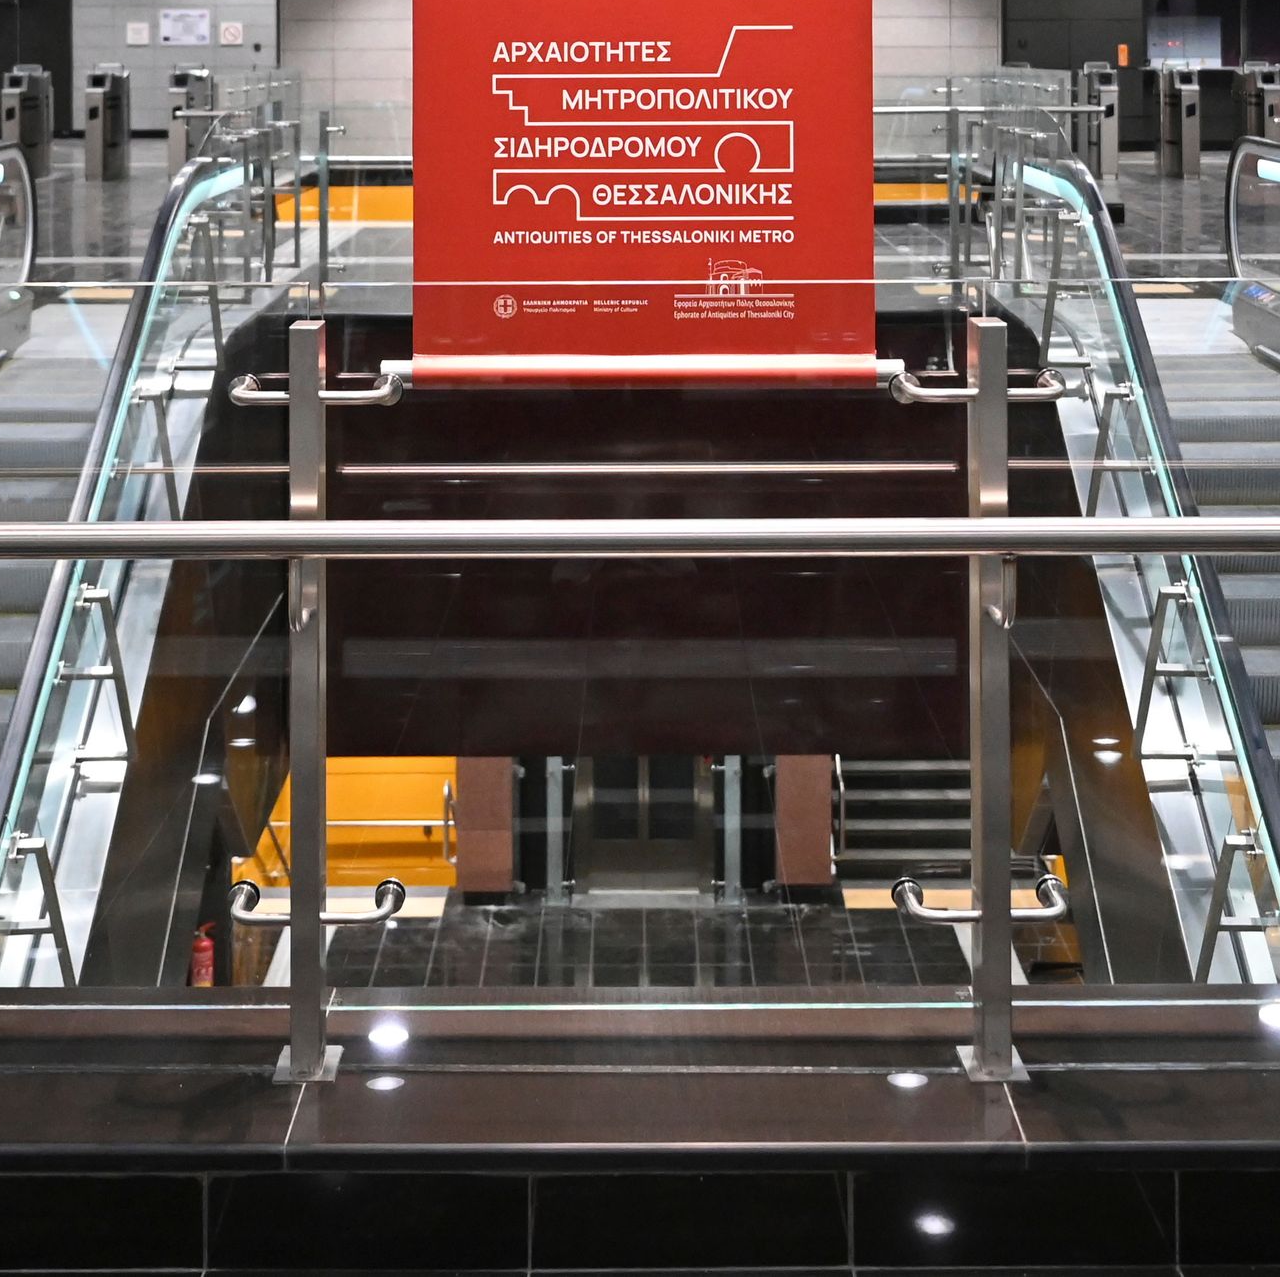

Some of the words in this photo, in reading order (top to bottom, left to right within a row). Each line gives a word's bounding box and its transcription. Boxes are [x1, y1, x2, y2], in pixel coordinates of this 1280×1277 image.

[492, 41, 672, 63] ΑΡΧΑΙΟΤΗΤΕΣ
[562, 87, 794, 110] ΜΗΤΡΟΠΟΛΙΤΙΚΟΥ
[493, 135, 702, 158] ΣΙΔΗΡΟΔΡΟΜΟΥ
[592, 183, 793, 206] ΘΕΣΣΑΛΟΝΙΚΗΣ
[493, 229, 593, 245] ANTIQUITIES
[595, 229, 617, 244] OF
[620, 229, 735, 244] THESSALONIKI
[739, 229, 795, 244] METRO
[673, 310, 700, 320] Ephorate
[700, 310, 708, 319] of
[707, 310, 740, 320] Antiquities
[739, 310, 747, 319] of
[746, 310, 783, 319] Thessaloniki
[782, 310, 795, 320] City
